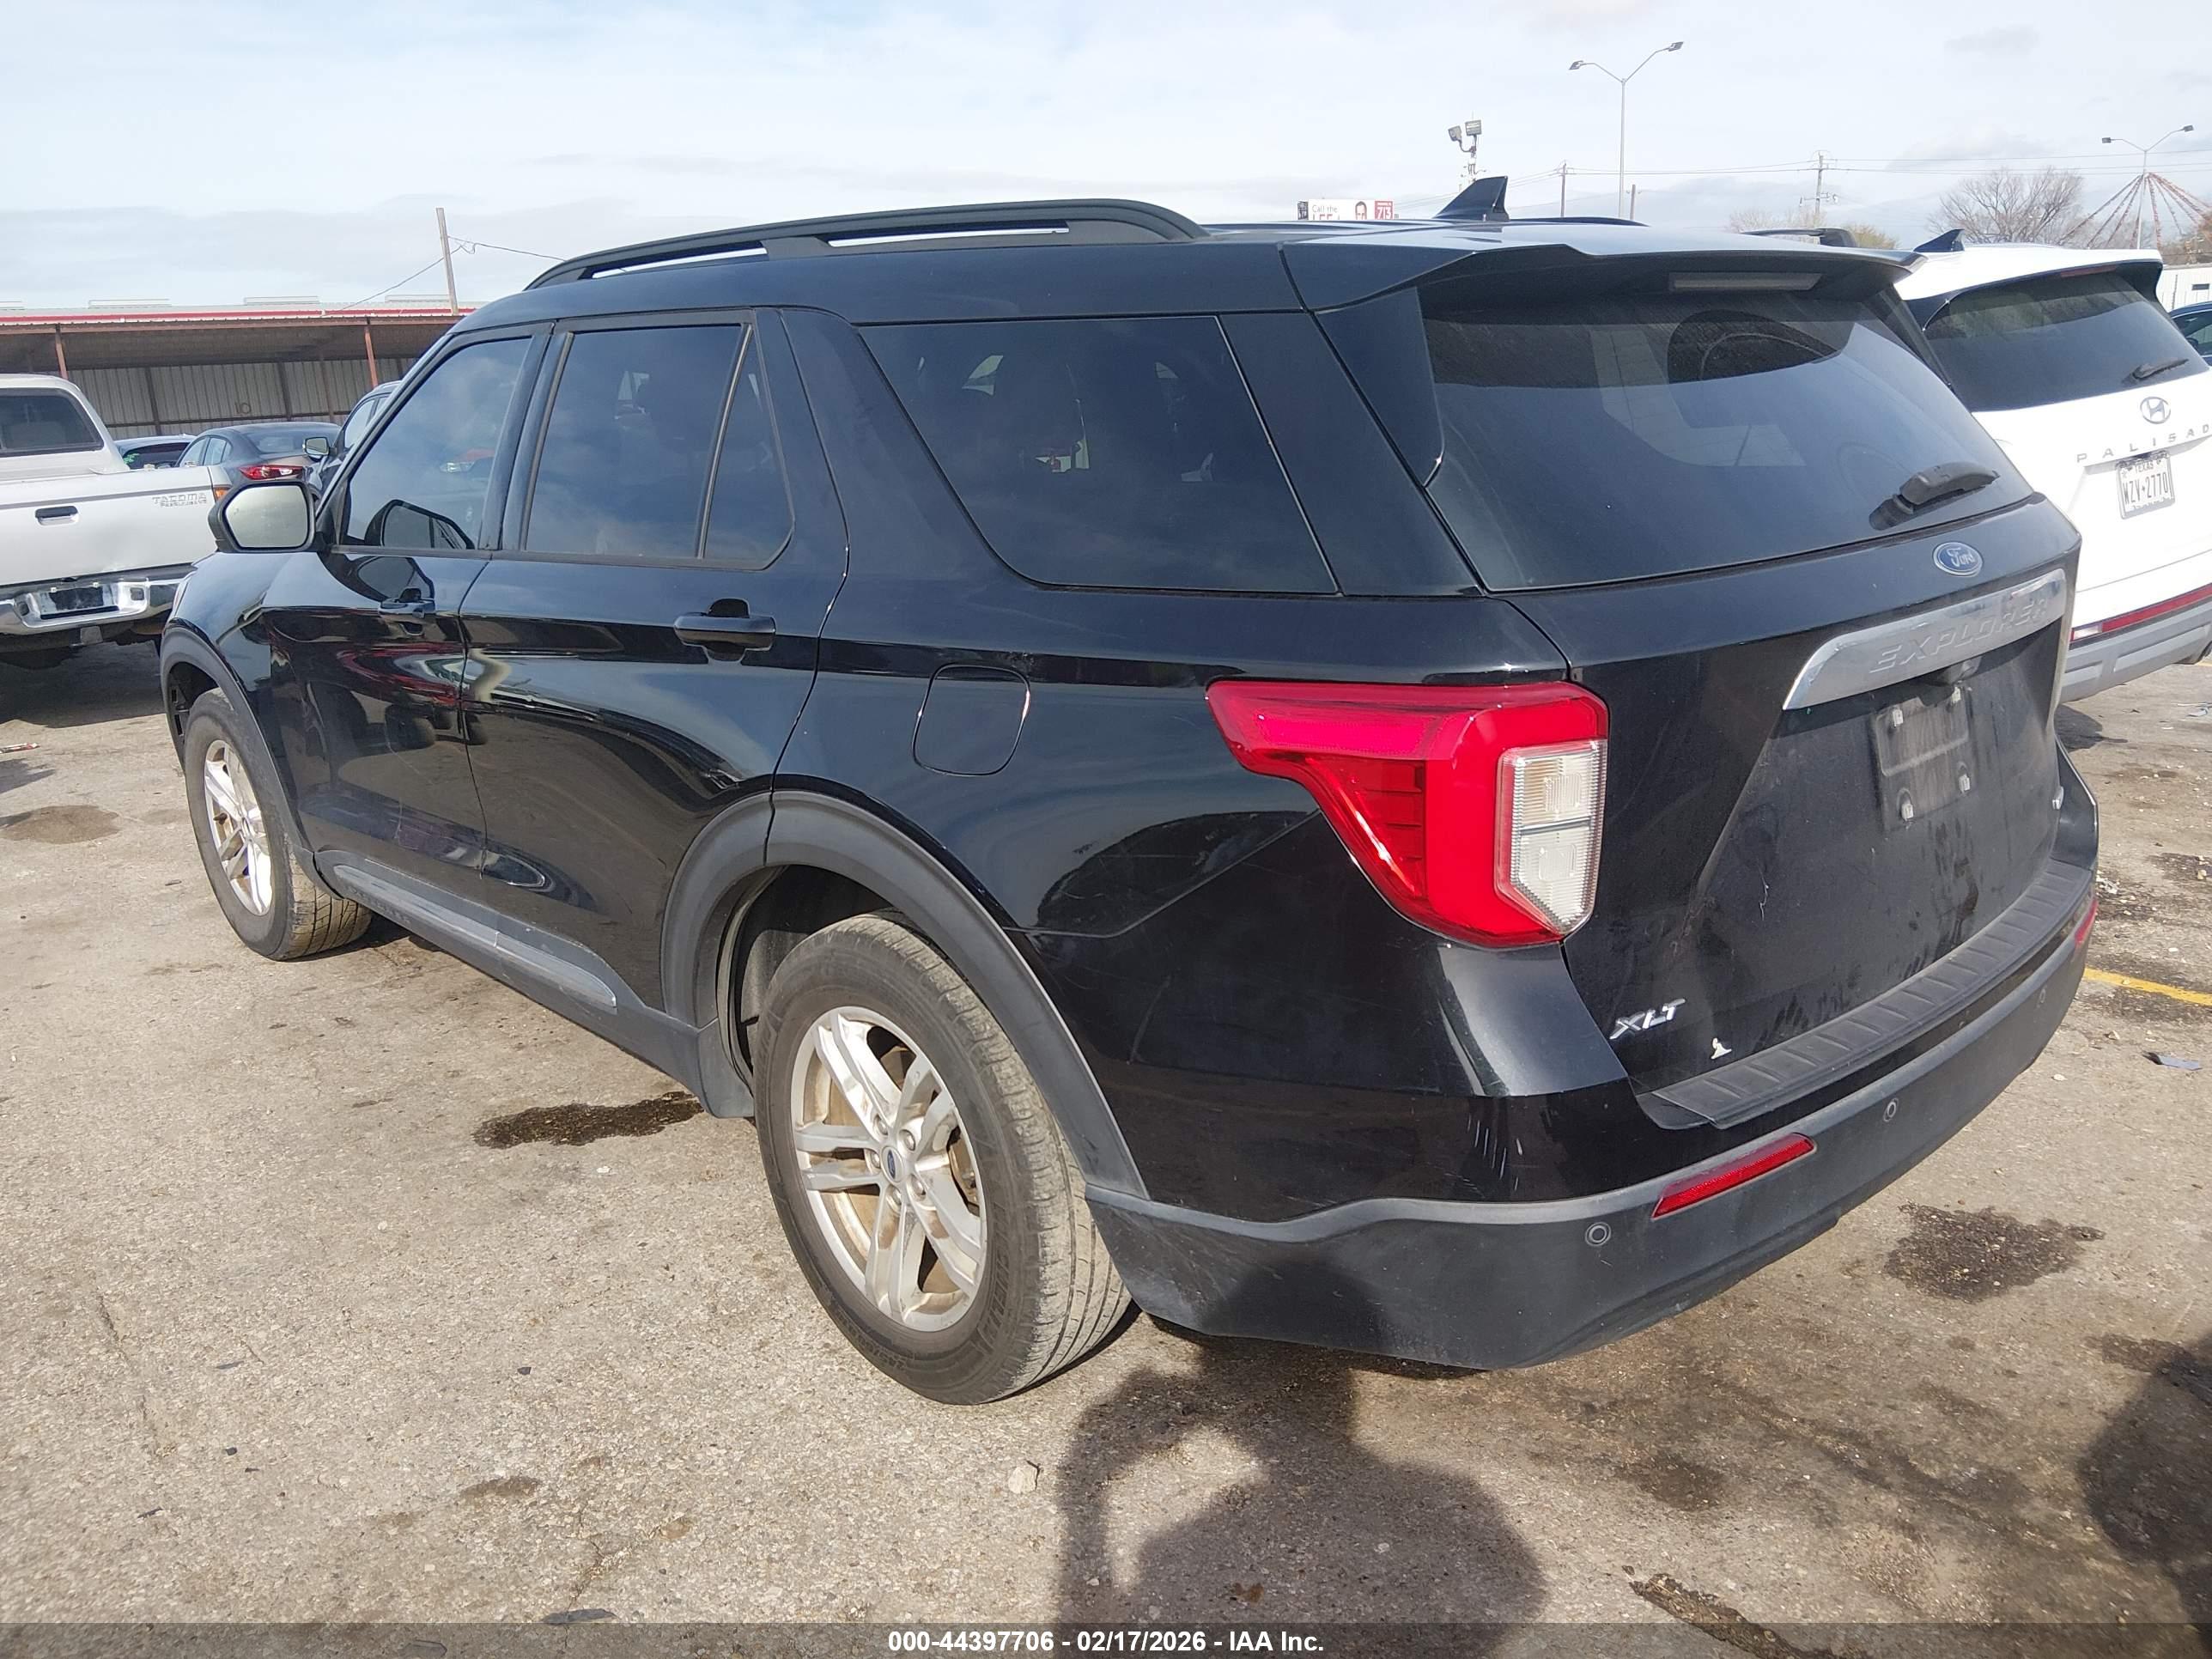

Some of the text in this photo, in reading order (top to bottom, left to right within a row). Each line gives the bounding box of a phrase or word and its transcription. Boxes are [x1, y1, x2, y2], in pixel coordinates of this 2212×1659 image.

[1312, 204, 1325, 213] Call
[2076, 424, 2209, 463] PALISAD
[1869, 599, 2048, 673] EXPLORER
[1609, 999, 1686, 1040] XLT
